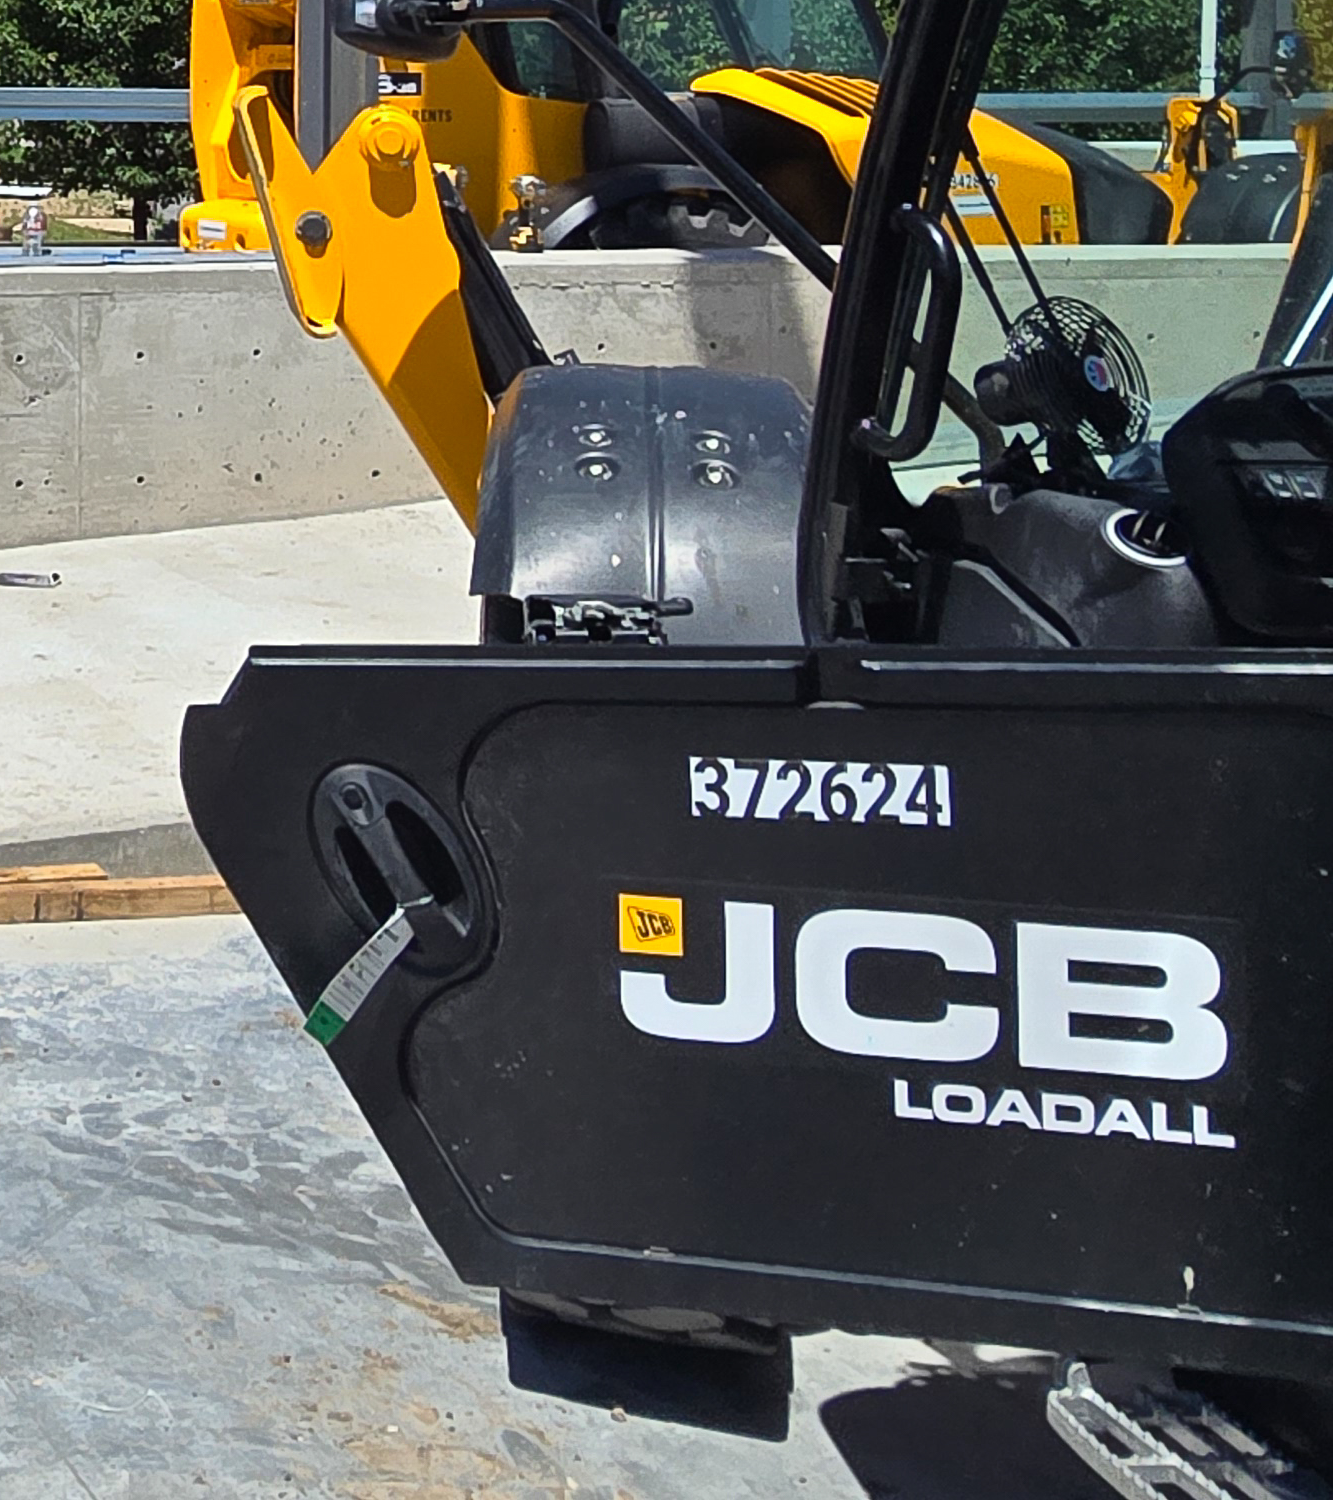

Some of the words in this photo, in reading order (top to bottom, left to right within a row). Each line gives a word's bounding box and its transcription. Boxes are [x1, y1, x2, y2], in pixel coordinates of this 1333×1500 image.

[693, 757, 944, 825] 372624
[636, 910, 673, 939] JCB
[619, 901, 1228, 1081] JCB
[894, 1078, 1237, 1149] LOADALL
